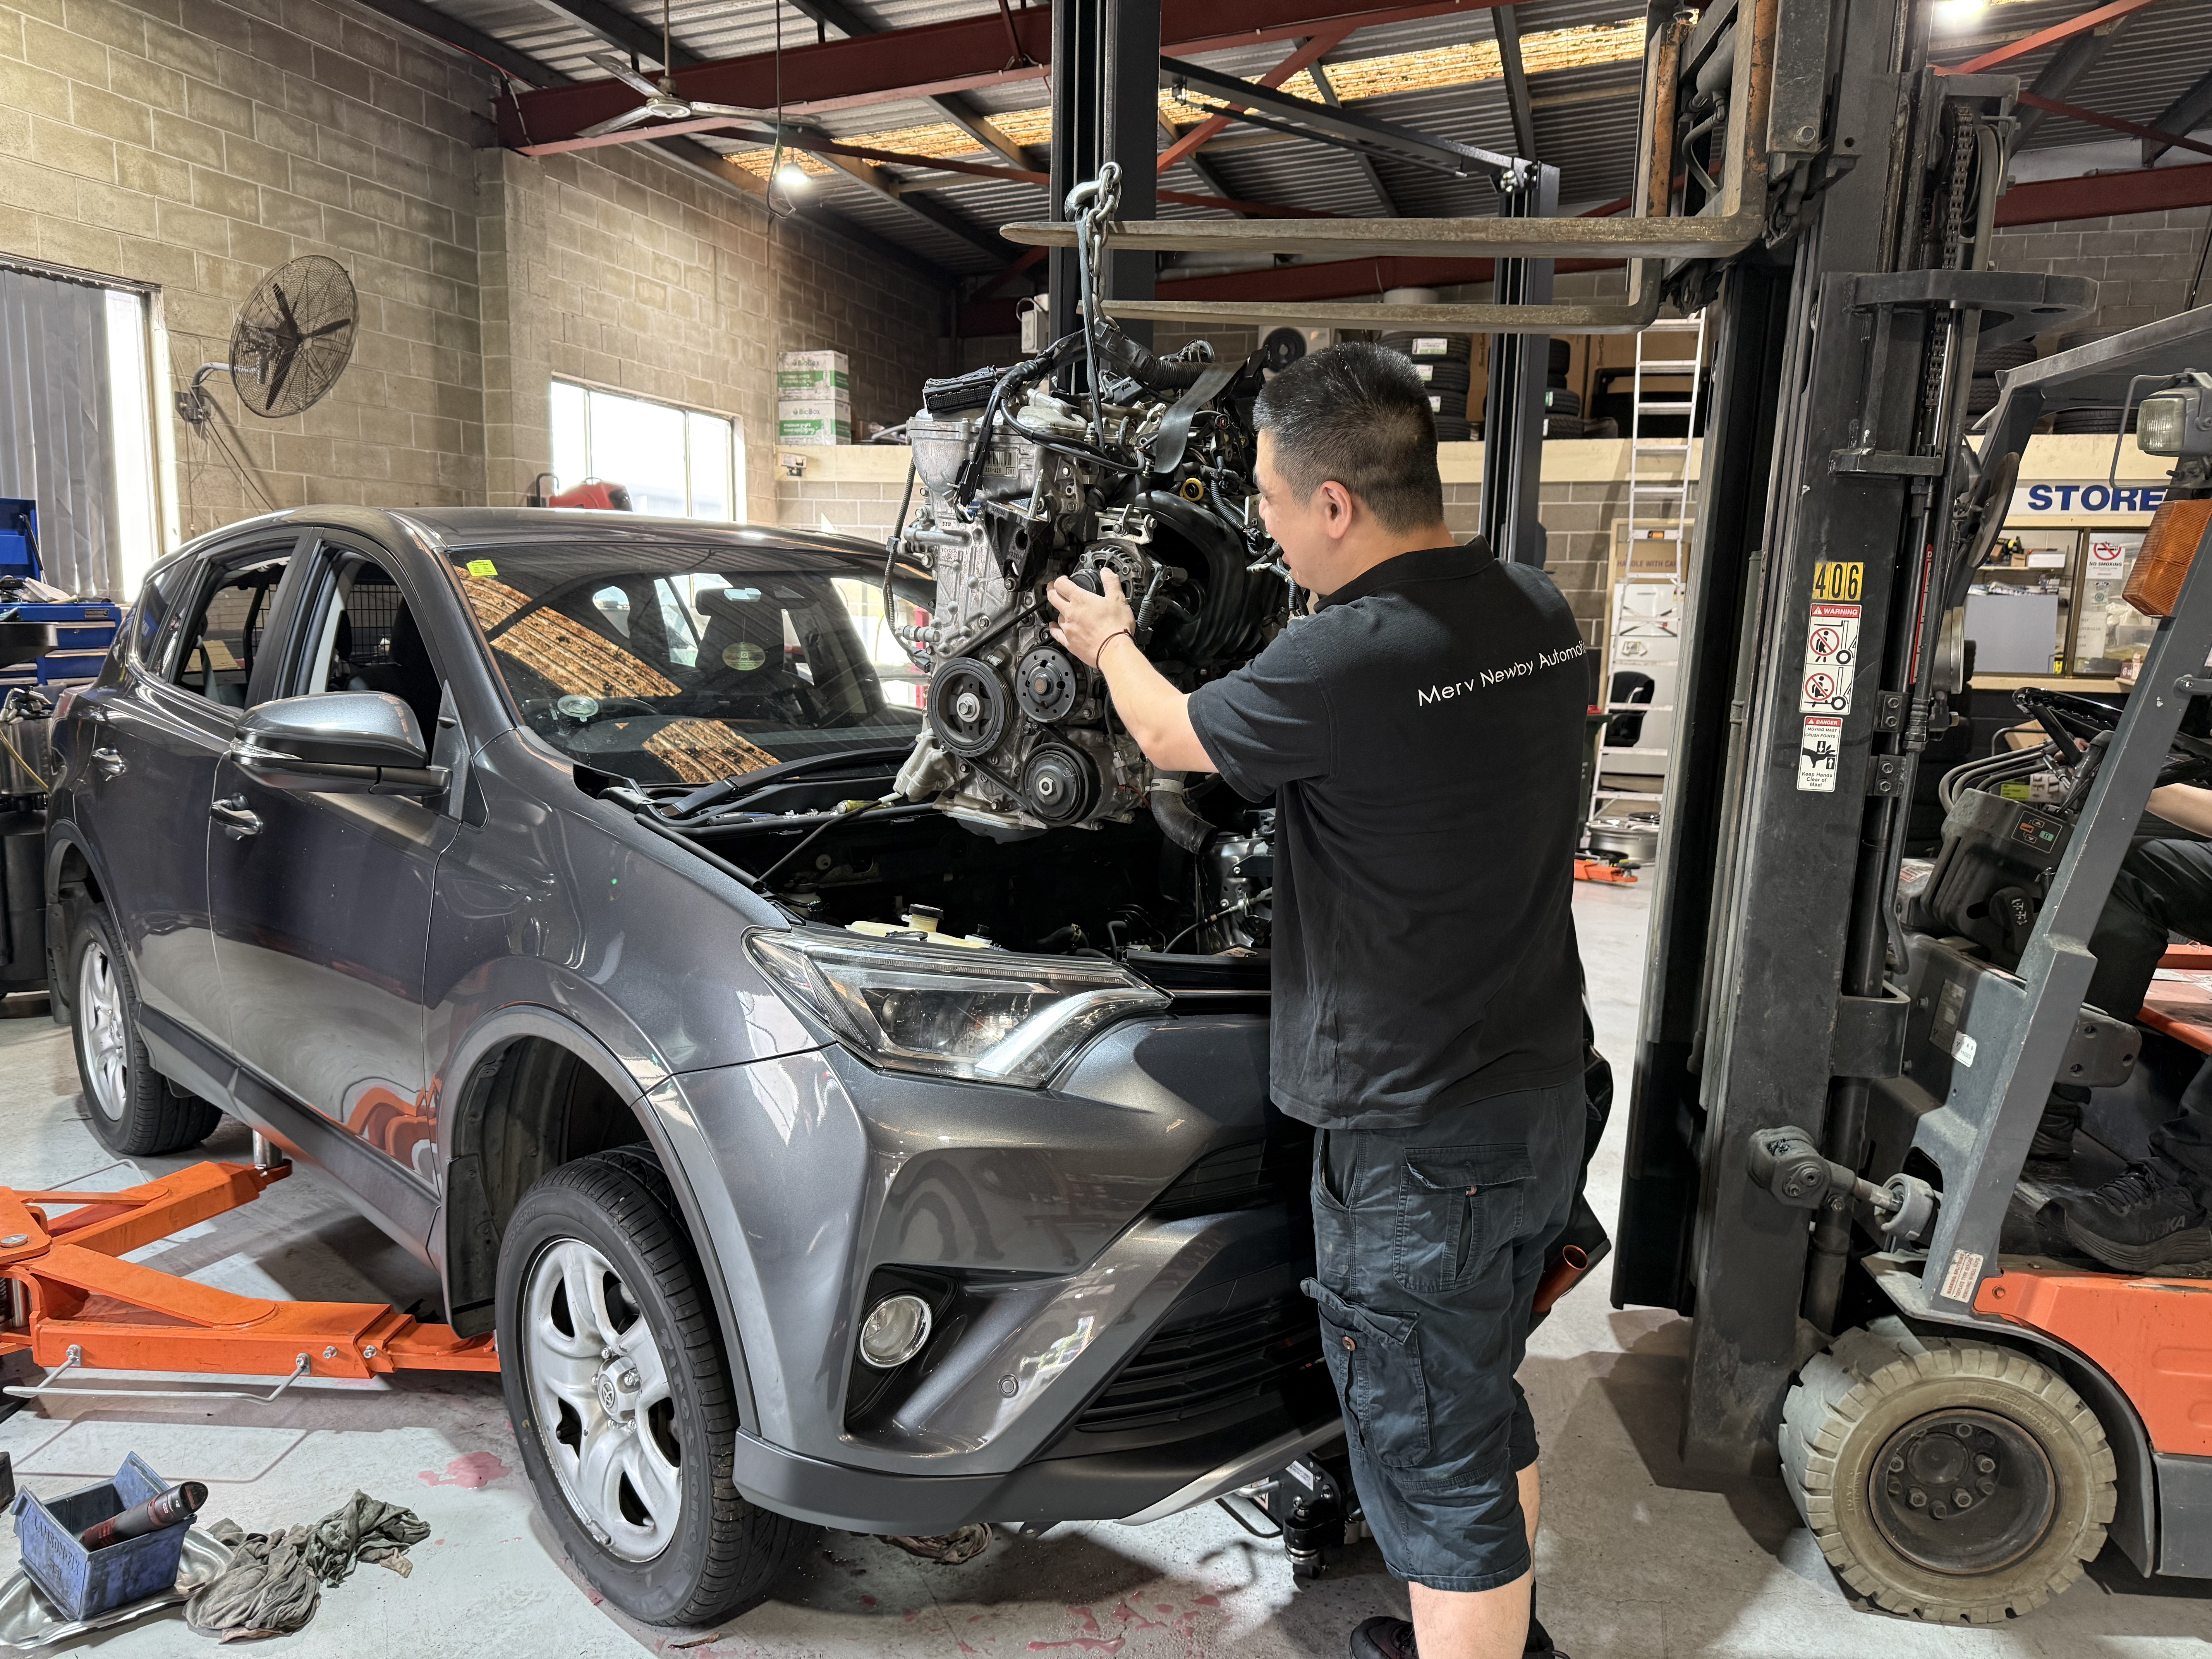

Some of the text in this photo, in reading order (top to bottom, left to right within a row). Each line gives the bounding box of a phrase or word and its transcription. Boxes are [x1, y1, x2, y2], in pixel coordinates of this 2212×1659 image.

[2028, 484, 2164, 511] STORE
[1815, 563, 1859, 599] 406
[1418, 678, 1474, 707] Merv
[1480, 660, 1533, 687] Newby
[1956, 1281, 1965, 1296] DEFLATE
[1965, 1257, 1973, 1271] BEFORE
[1961, 1280, 1972, 1299] REMOVING
